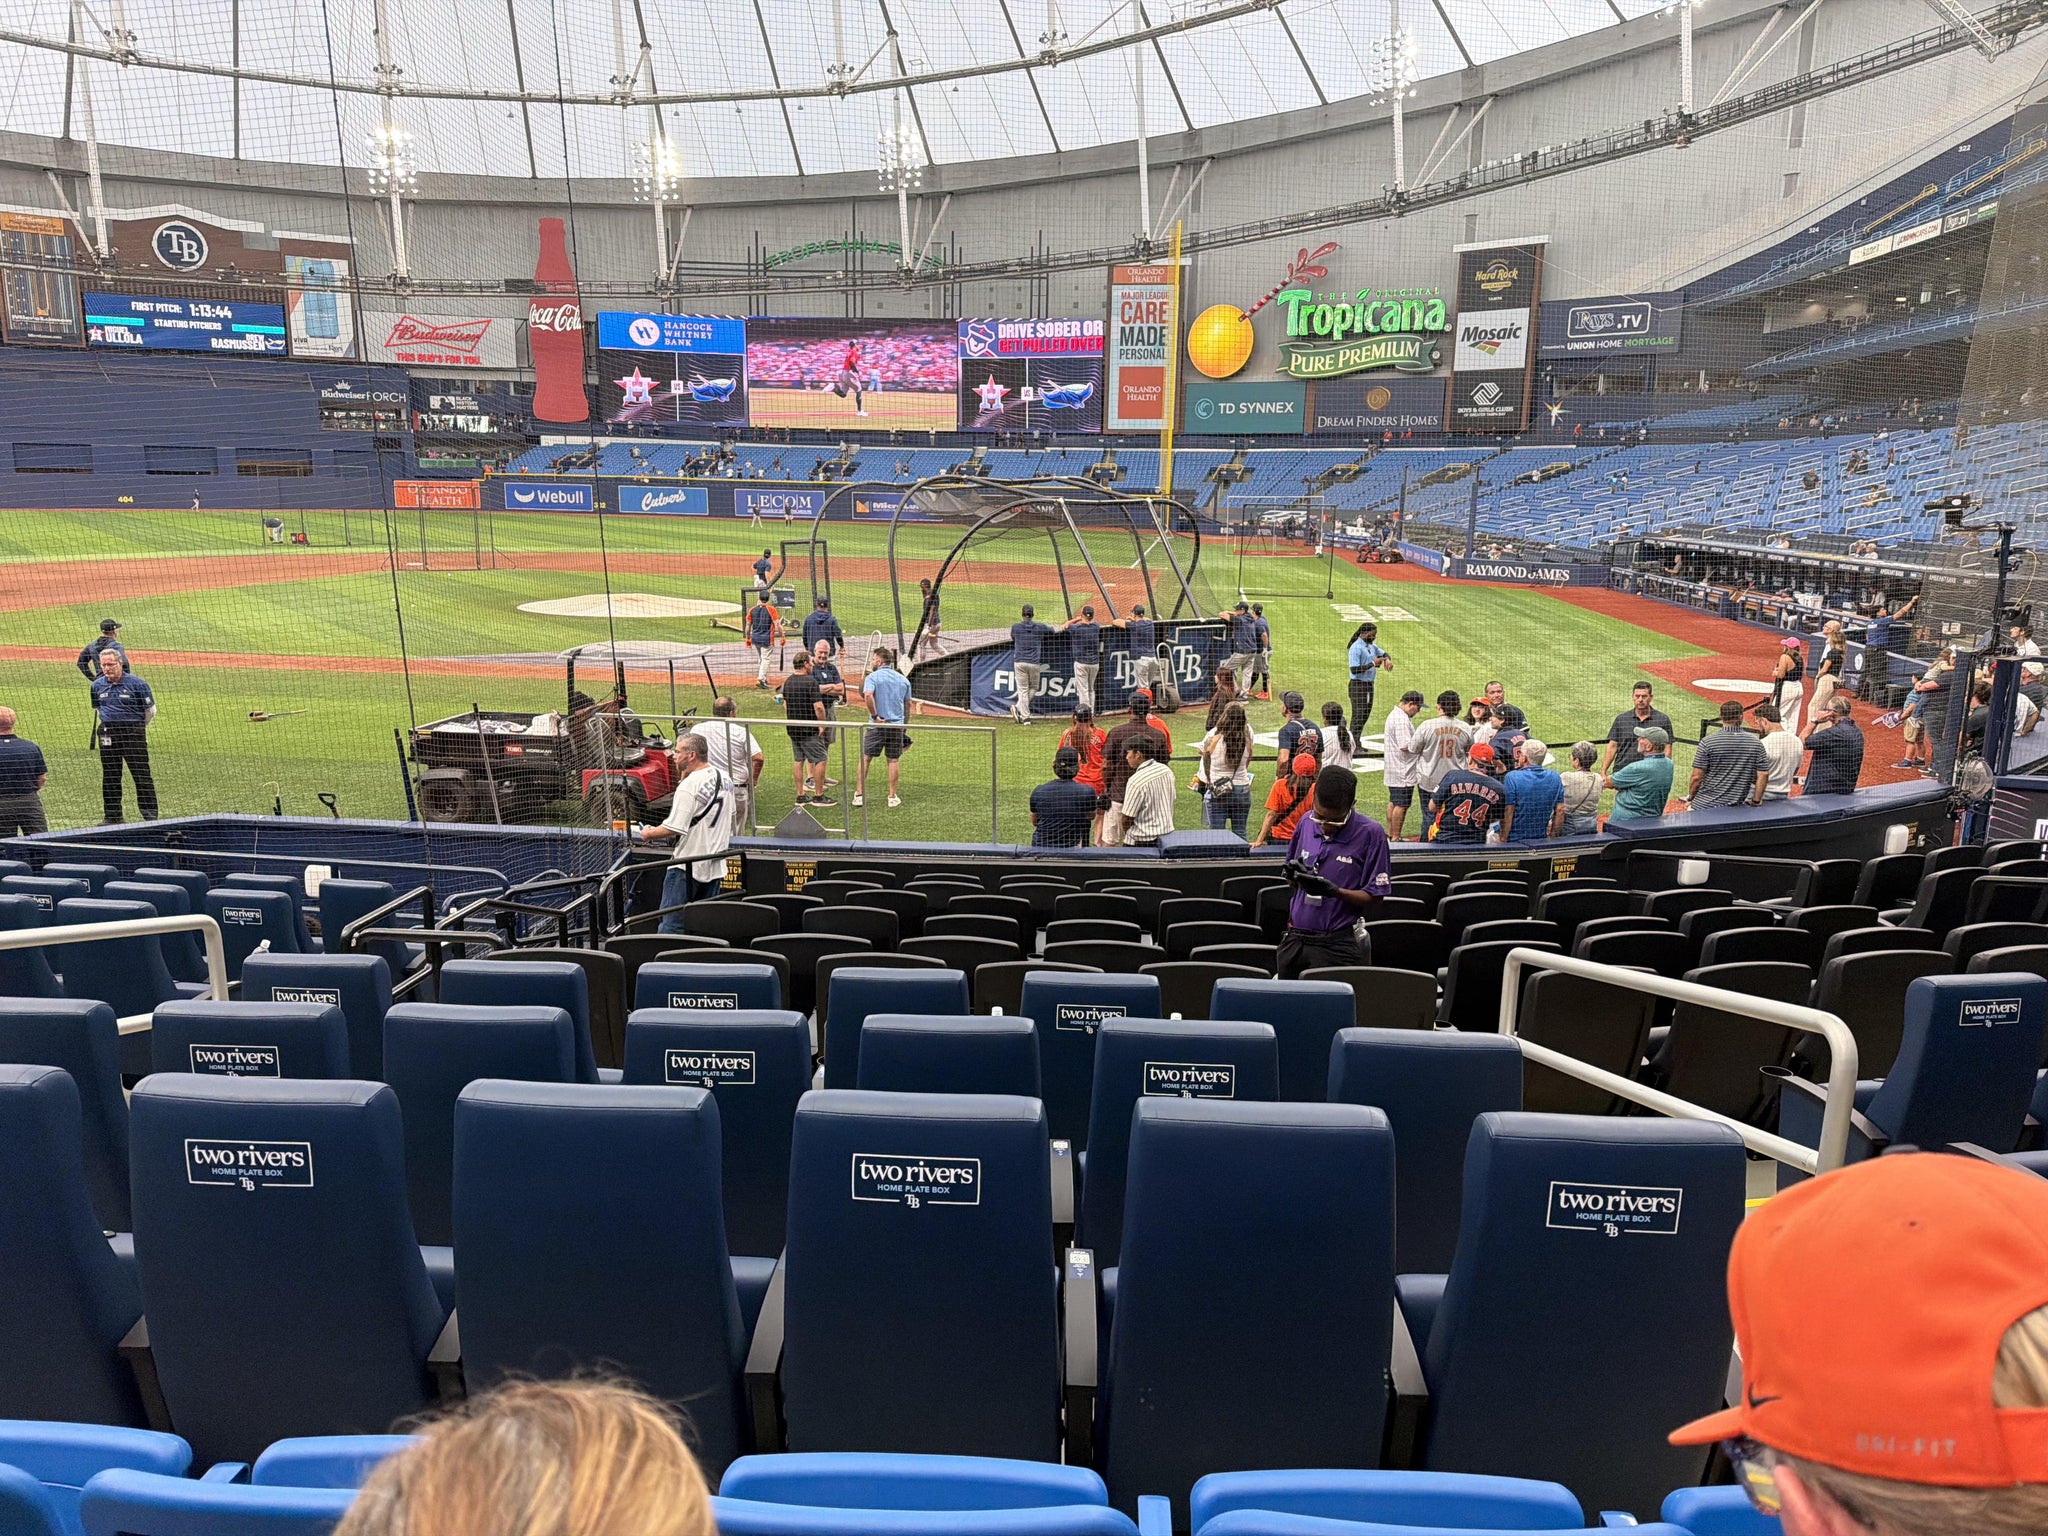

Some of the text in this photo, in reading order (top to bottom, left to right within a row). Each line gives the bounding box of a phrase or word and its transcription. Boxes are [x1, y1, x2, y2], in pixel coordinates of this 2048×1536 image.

[1808, 226, 1820, 234] 324
[162, 231, 200, 262] TB
[765, 239, 882, 269] TROPICANA
[1127, 267, 1165, 275] ORLANDO
[1474, 268, 1519, 281] Hard Rock
[1131, 275, 1160, 283] HEALTH
[1121, 291, 1144, 299] MAJOR
[1318, 287, 1440, 300] THE ORIGINAL
[131, 301, 232, 318] FIRST PITCH: 1:13:44
[1120, 301, 1168, 324] CARE
[1277, 289, 1446, 340] Tropicana
[529, 303, 584, 332] Coca-Cola
[154, 319, 222, 331] STARTING PITCHERS
[664, 321, 713, 331] HANCOCK
[998, 320, 1104, 338] DRIVE SOBER OR
[105, 331, 143, 344] ULLOLA
[393, 324, 481, 342] Budweiser
[663, 330, 713, 339] WHITNEY
[1119, 326, 1167, 346] MADE
[1460, 322, 1522, 343] Mosaic
[211, 338, 266, 350] RASMUSSEN
[664, 338, 692, 346] BANK
[998, 336, 1104, 352] GET PULLED OVER
[1566, 341, 1596, 350] UNION
[1596, 339, 1622, 349] HOME
[1624, 337, 1675, 347] MORTGAGE
[397, 352, 415, 362] THIS
[417, 353, 443, 363] BUD'S
[445, 354, 461, 364] FOR
[1119, 348, 1167, 360] PERSONAL
[1290, 341, 1421, 373] PURE PREMIUM
[321, 389, 366, 400] Budweiser
[1123, 384, 1161, 392] ORLANDO
[1127, 393, 1157, 401] HEALTH
[1218, 402, 1294, 414] TD SYNNEX
[1317, 414, 1438, 427] DREAM FINDERS HOMES
[407, 483, 468, 494] ORLANDO
[415, 495, 463, 505] HEALTH
[537, 489, 584, 504] Webull
[641, 489, 687, 511] Culver's
[1466, 564, 1570, 582] RAYMOND JAMES
[1173, 645, 1202, 683] TB
[1450, 782, 1500, 804] ALVAREZ
[1453, 798, 1490, 828] 44
[787, 868, 814, 876] WATCH
[1554, 864, 1575, 872] WATCH
[793, 876, 808, 884] OUT
[1557, 872, 1570, 880] OUT
[225, 908, 238, 917] two
[238, 909, 260, 919] rivers
[275, 989, 336, 1003] two rivers
[672, 995, 734, 1008] two rivers
[1061, 1007, 1084, 1019] two
[1965, 1001, 2018, 1015] two rivers
[195, 1048, 274, 1064] two rivers
[671, 1053, 750, 1070] two rivers
[1150, 1066, 1230, 1083] two rivers
[192, 1144, 305, 1167] two rivers
[211, 1167, 283, 1177] HOME PLATE BOX
[859, 1159, 973, 1184] two rivers
[877, 1183, 950, 1194] HOME PLATE BOX
[1559, 1188, 1675, 1213] two rivers
[1575, 1212, 1651, 1223] HOME PLATE BOX
